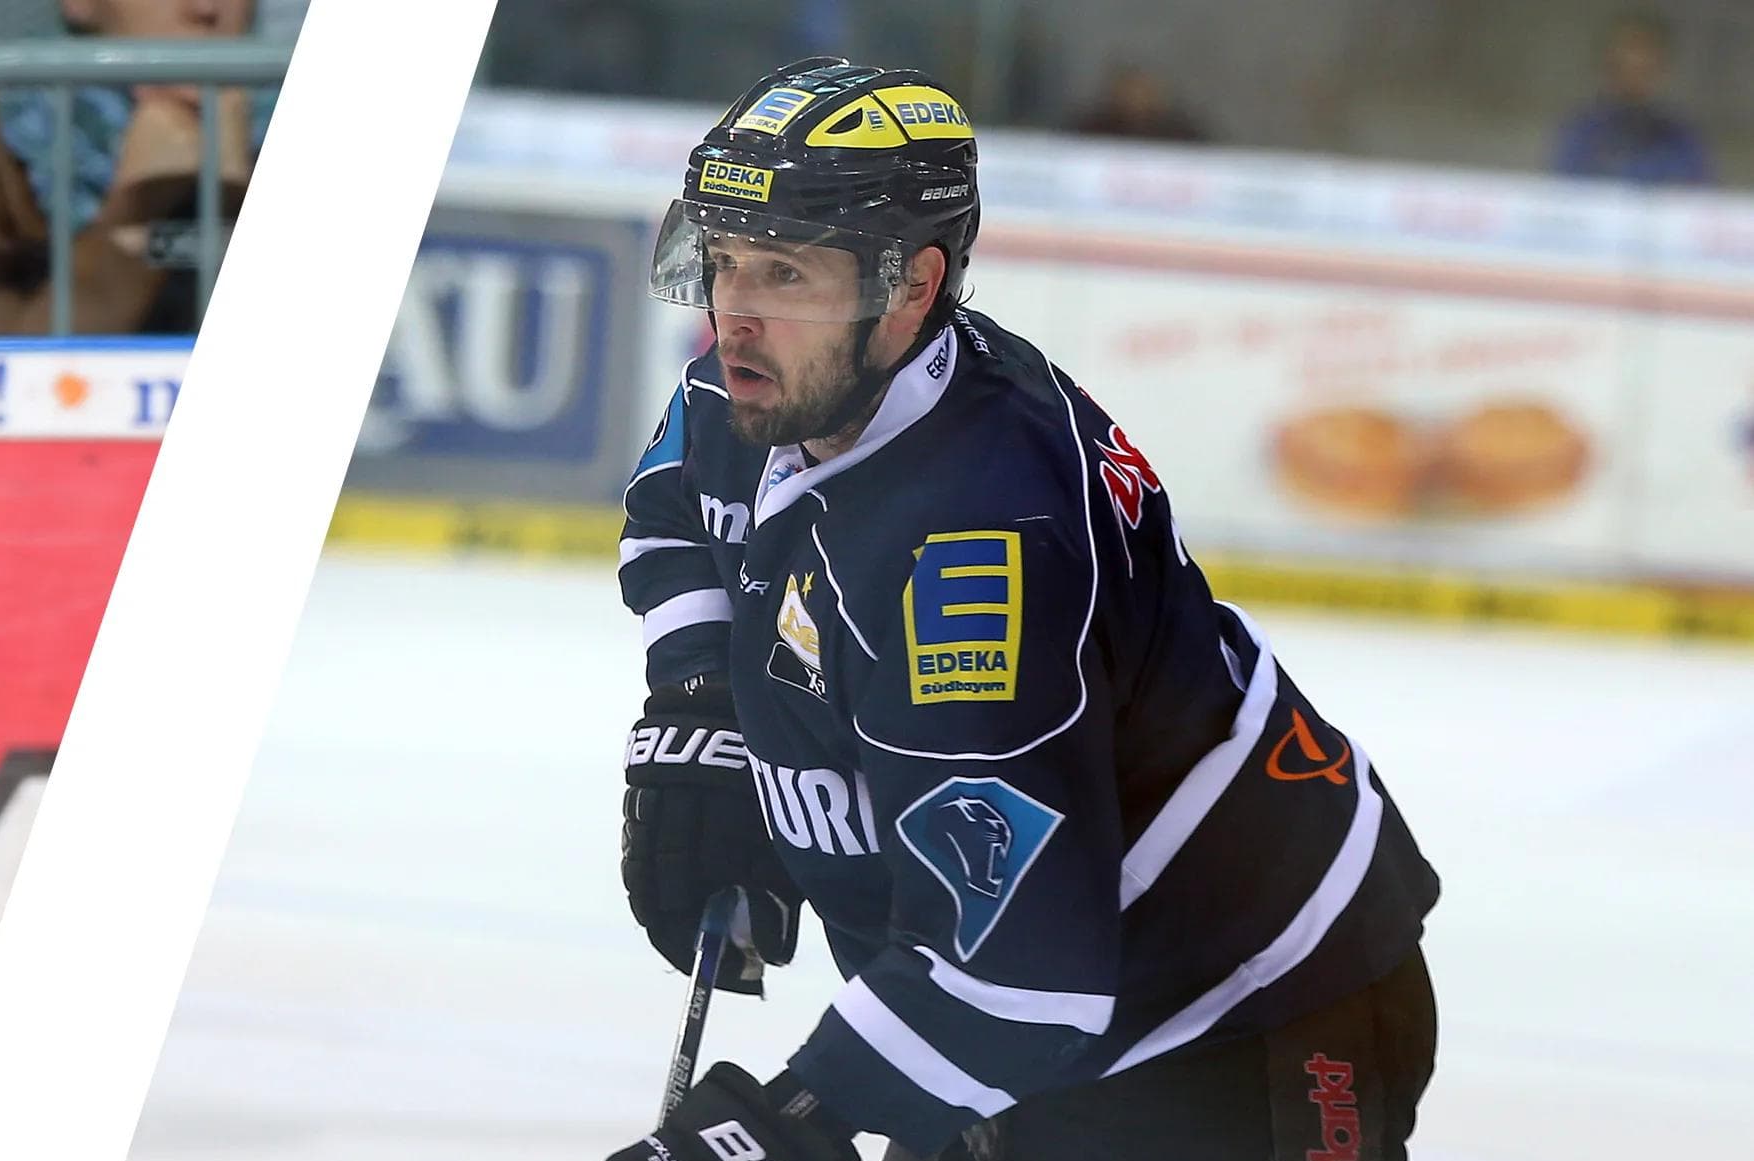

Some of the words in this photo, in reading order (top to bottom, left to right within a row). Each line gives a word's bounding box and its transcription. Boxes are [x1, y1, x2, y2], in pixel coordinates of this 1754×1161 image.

[896, 102, 971, 127] EDEKA
[705, 163, 765, 187] EDEKA
[917, 650, 1008, 676] EDEKA
